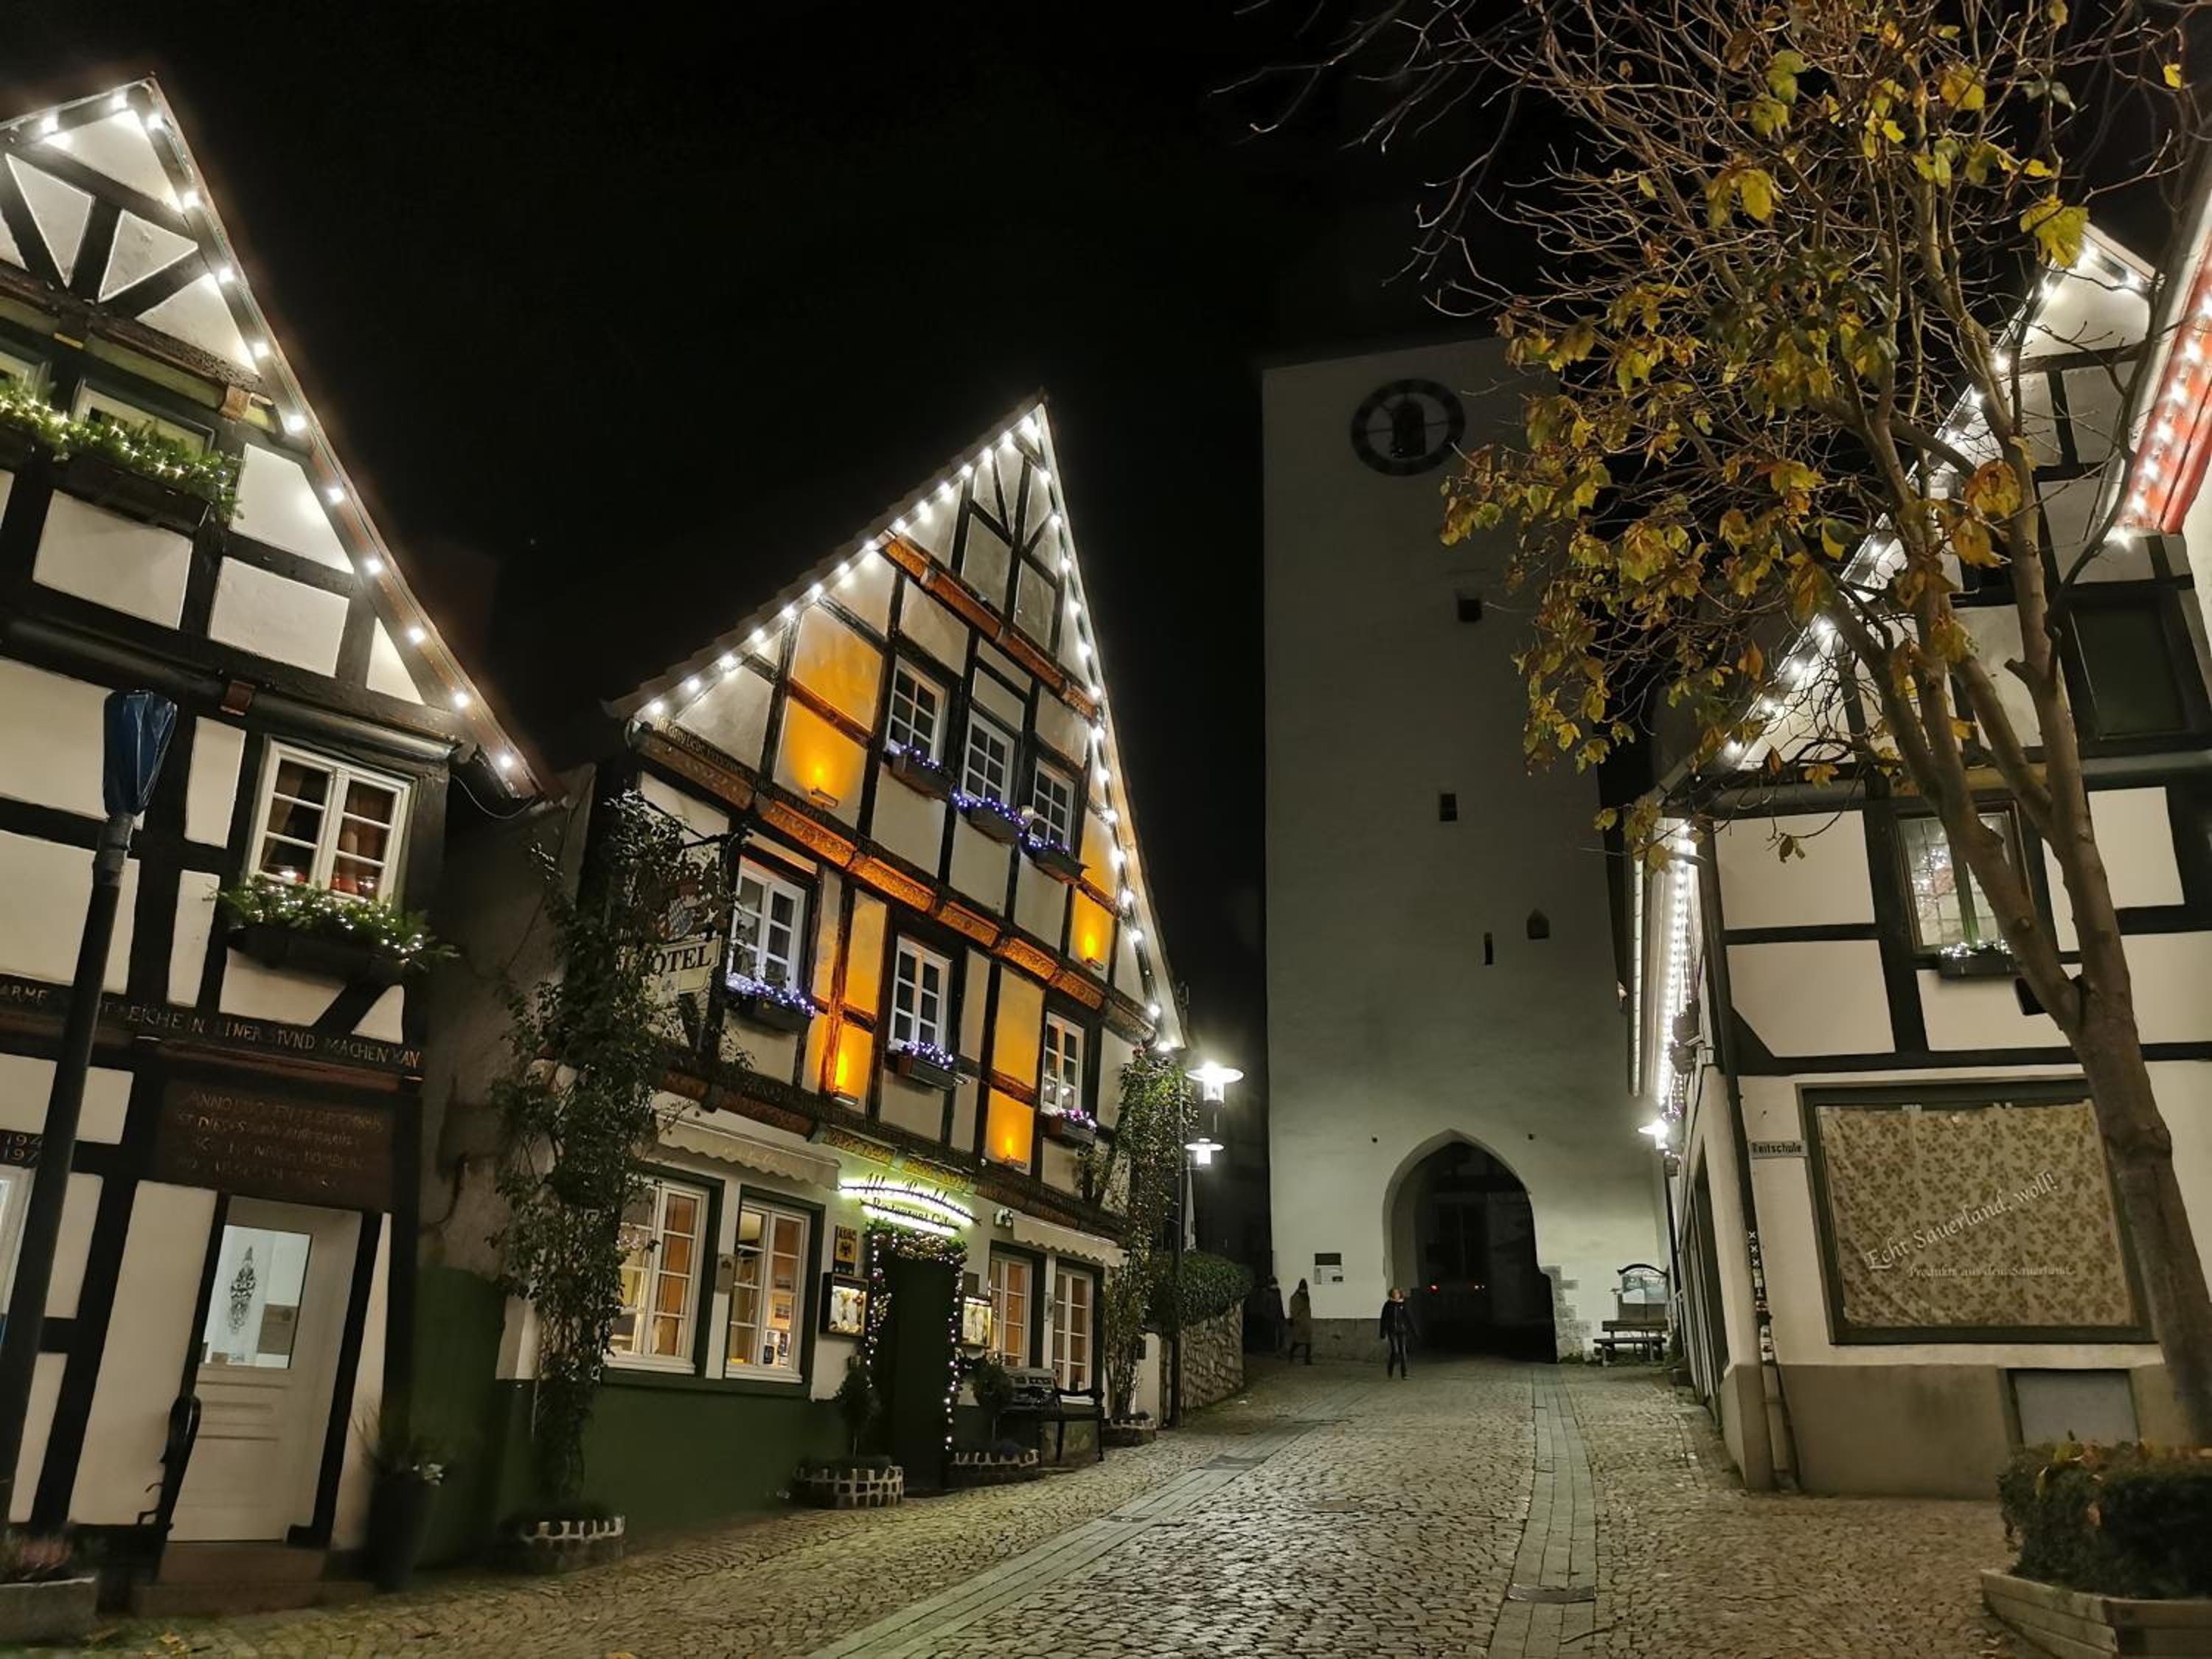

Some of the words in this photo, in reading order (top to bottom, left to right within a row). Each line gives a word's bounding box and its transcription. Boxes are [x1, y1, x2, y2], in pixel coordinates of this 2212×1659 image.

[653, 946, 712, 974] OTEL
[1864, 1237, 1909, 1269] Echt
[1913, 1188, 2014, 1248] Sauerland,
[2014, 1169, 2059, 1203] woll!
